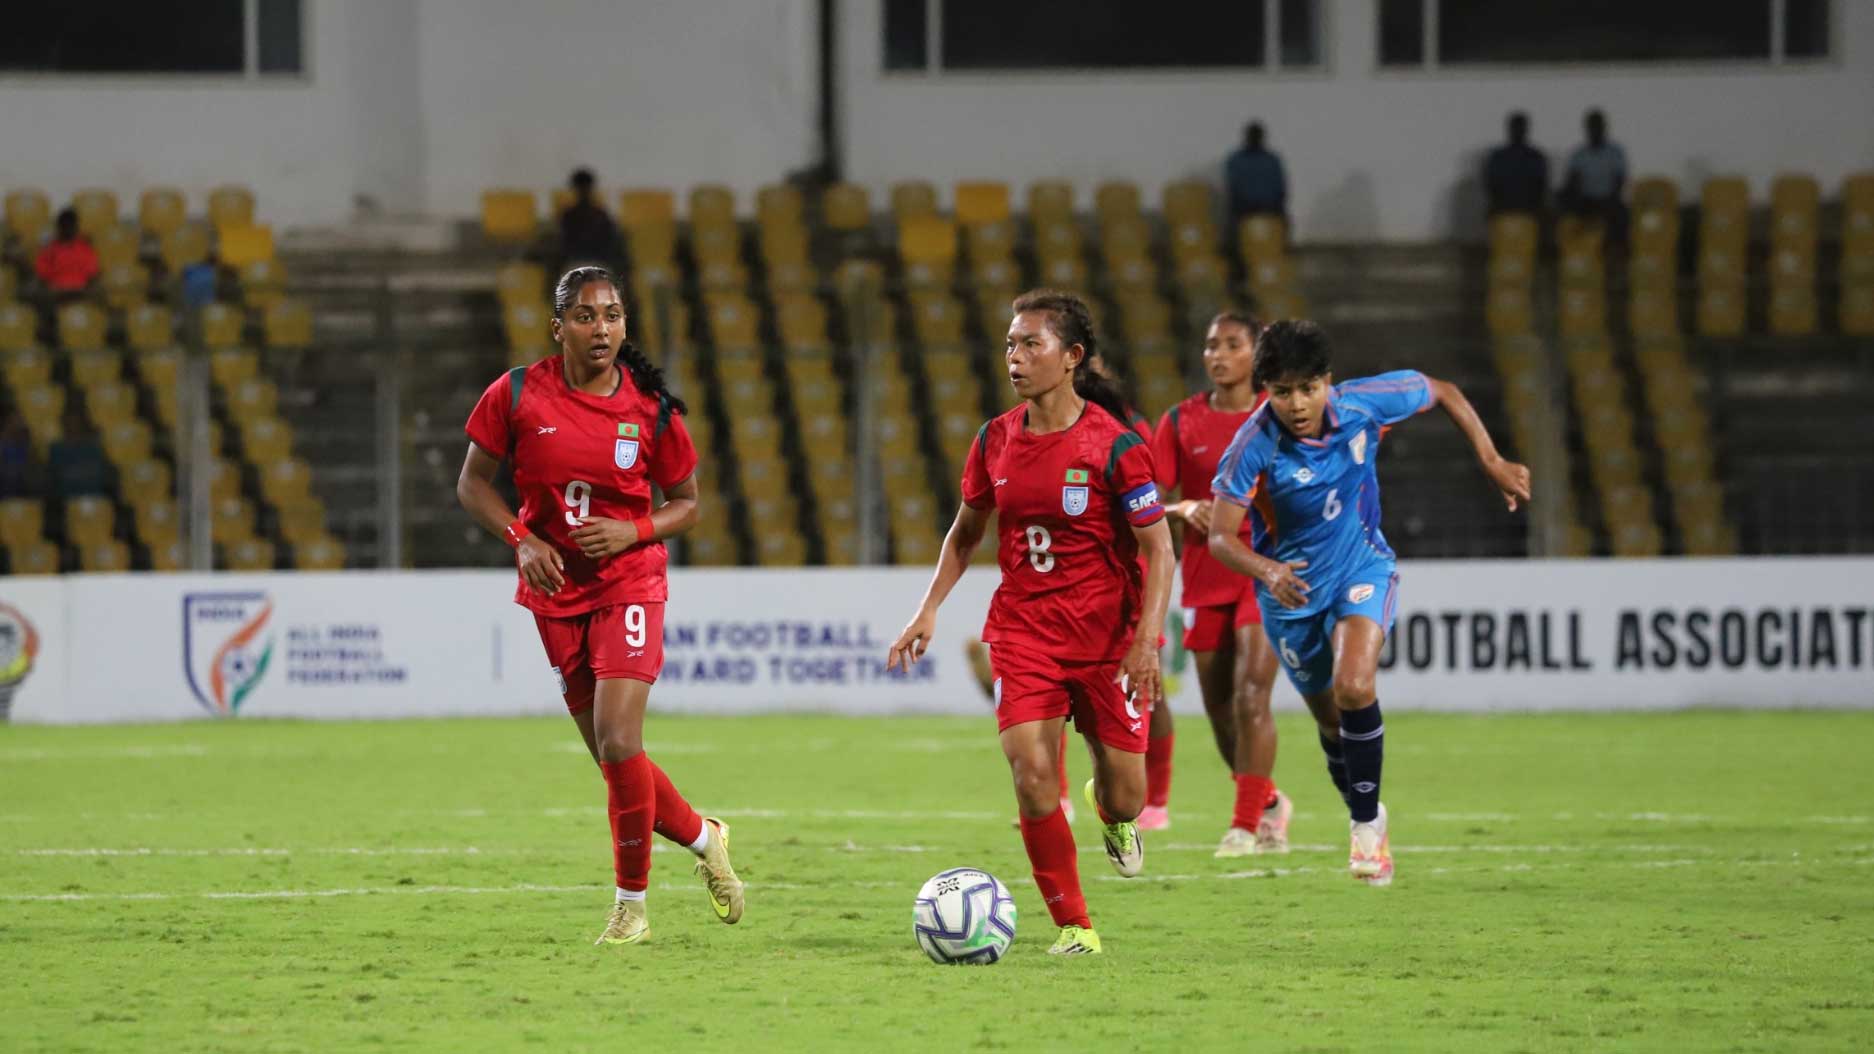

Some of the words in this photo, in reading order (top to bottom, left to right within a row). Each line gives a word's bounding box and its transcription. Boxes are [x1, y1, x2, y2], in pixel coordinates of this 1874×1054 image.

[564, 480, 592, 526] 9
[1322, 488, 1342, 521] 6
[1026, 525, 1055, 573] 8
[625, 604, 646, 648] 9
[1614, 610, 1874, 669] ASSOCIAT
[1279, 637, 1301, 670] 6
